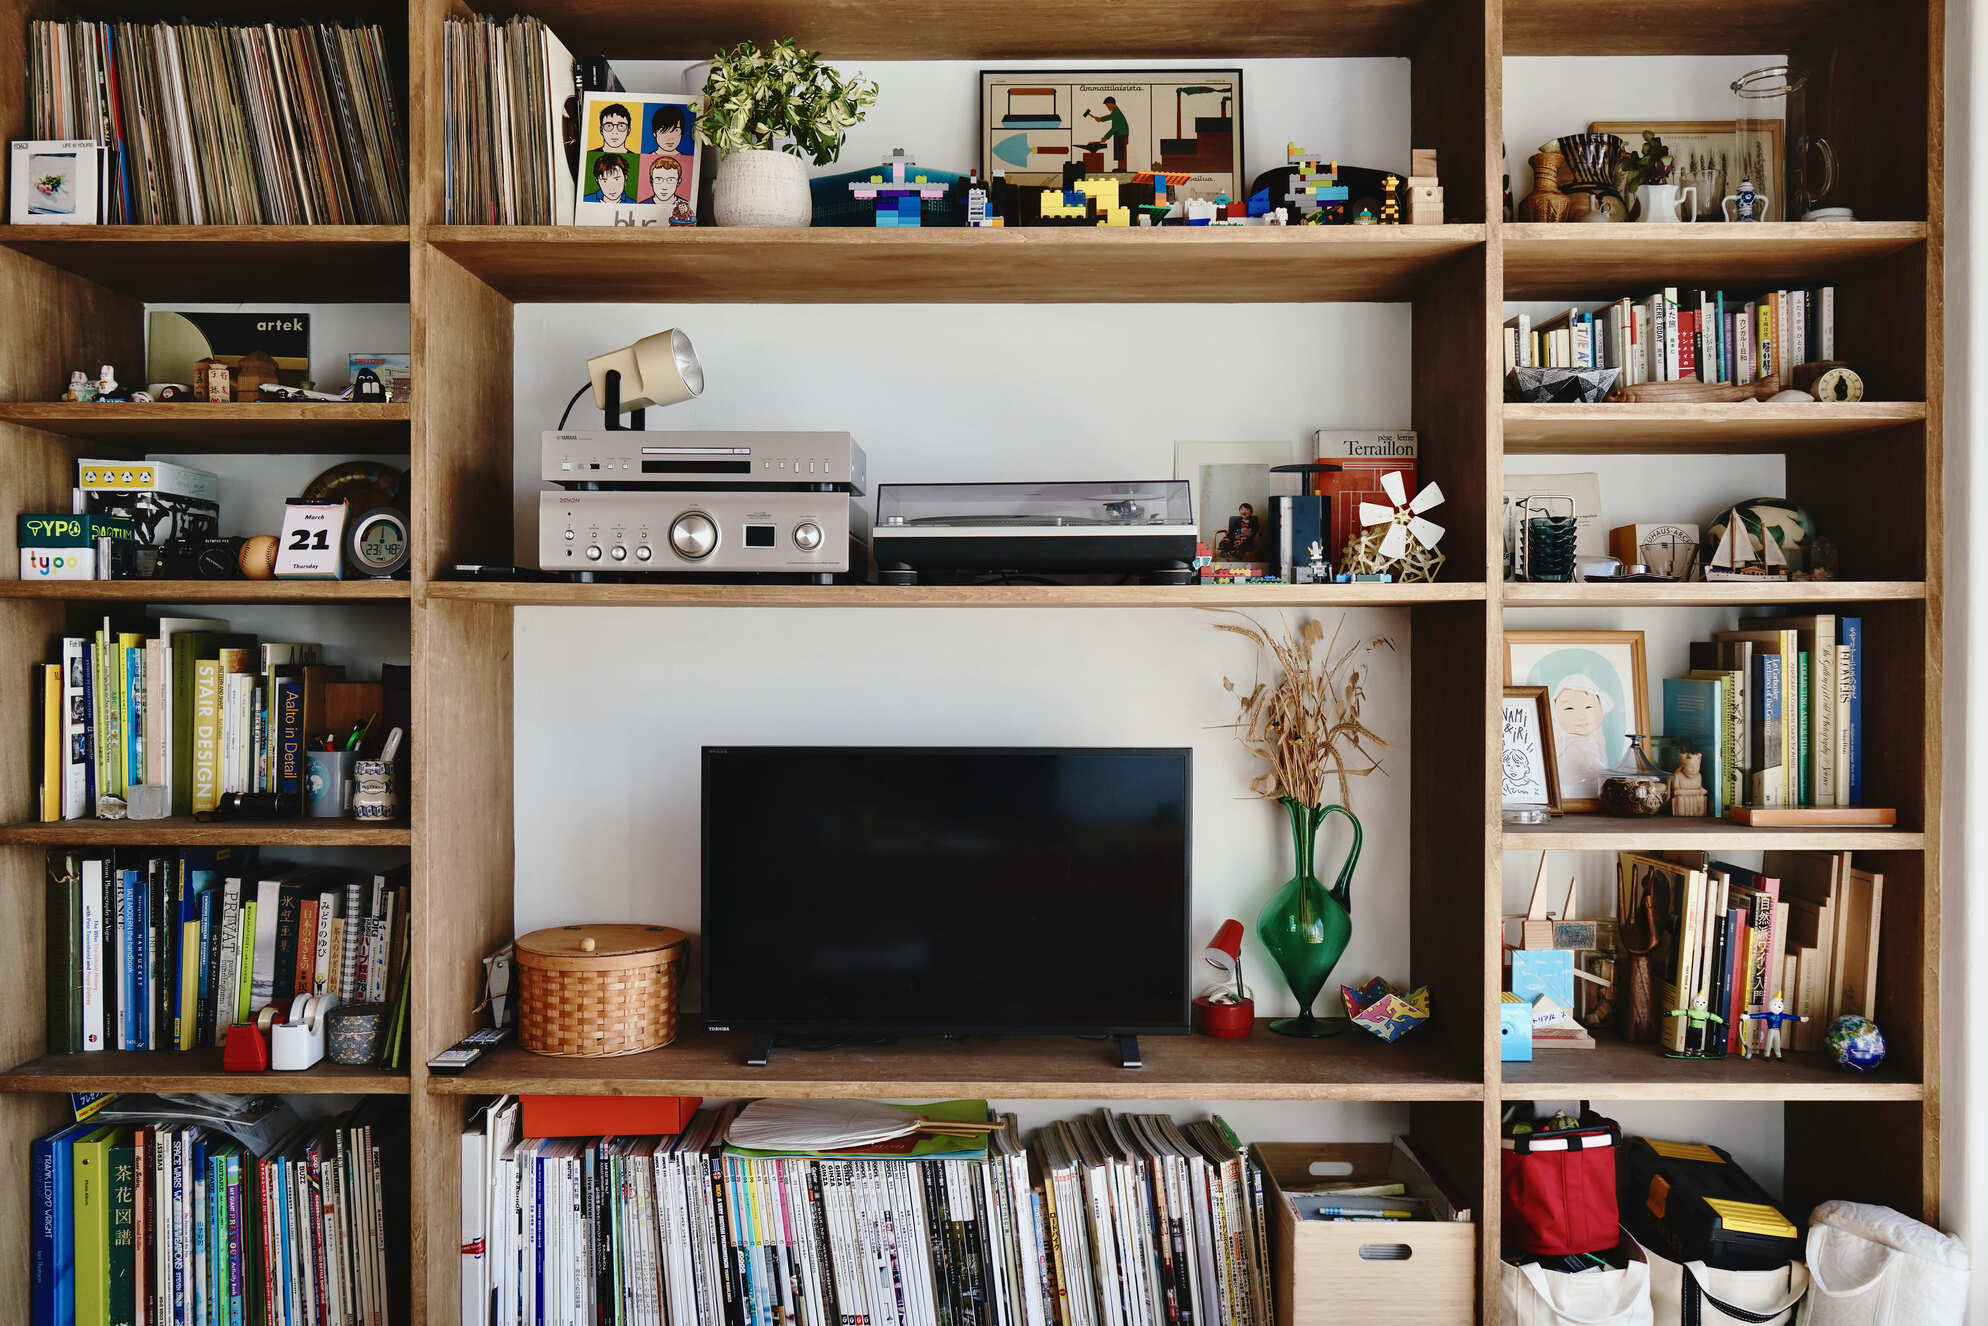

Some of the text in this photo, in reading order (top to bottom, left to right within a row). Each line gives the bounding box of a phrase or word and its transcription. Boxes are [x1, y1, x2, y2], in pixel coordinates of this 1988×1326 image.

[257, 318, 303, 331] artek
[1656, 303, 1664, 320] HERE
[1344, 441, 1415, 457] Terraillon
[288, 529, 330, 551] 21
[31, 551, 78, 577] typo
[293, 563, 319, 571] Thursday
[1765, 658, 1774, 688] Architect
[1772, 668, 1780, 701] Corbusier
[1840, 651, 1851, 704] FLOWERS
[196, 665, 215, 798] STAIR DESIGN
[283, 690, 300, 779] Aalto in Detail
[104, 880, 114, 917] Photography
[117, 878, 126, 930] FRANCE
[127, 888, 135, 902] TATE
[127, 902, 135, 930] MODERN
[222, 891, 240, 953] PRIVAT
[318, 901, 331, 957] みどりのゆび
[128, 942, 136, 973] handbook
[173, 1141, 182, 1165] SPACE
[173, 1166, 182, 1188] WARS
[208, 1160, 217, 1194] ABITARE
[218, 1159, 226, 1193] ABITARE
[821, 1164, 829, 1186] GINZA
[43, 1154, 55, 1241] FRANK LLOYD WRIGHT
[229, 1187, 236, 1195] MY
[587, 1191, 595, 1220] forever
[114, 1164, 133, 1248] 茶花図譜
[229, 1213, 237, 1241] PRESS
[173, 1230, 183, 1270] WEAPONS
[230, 1242, 238, 1261] OUT
